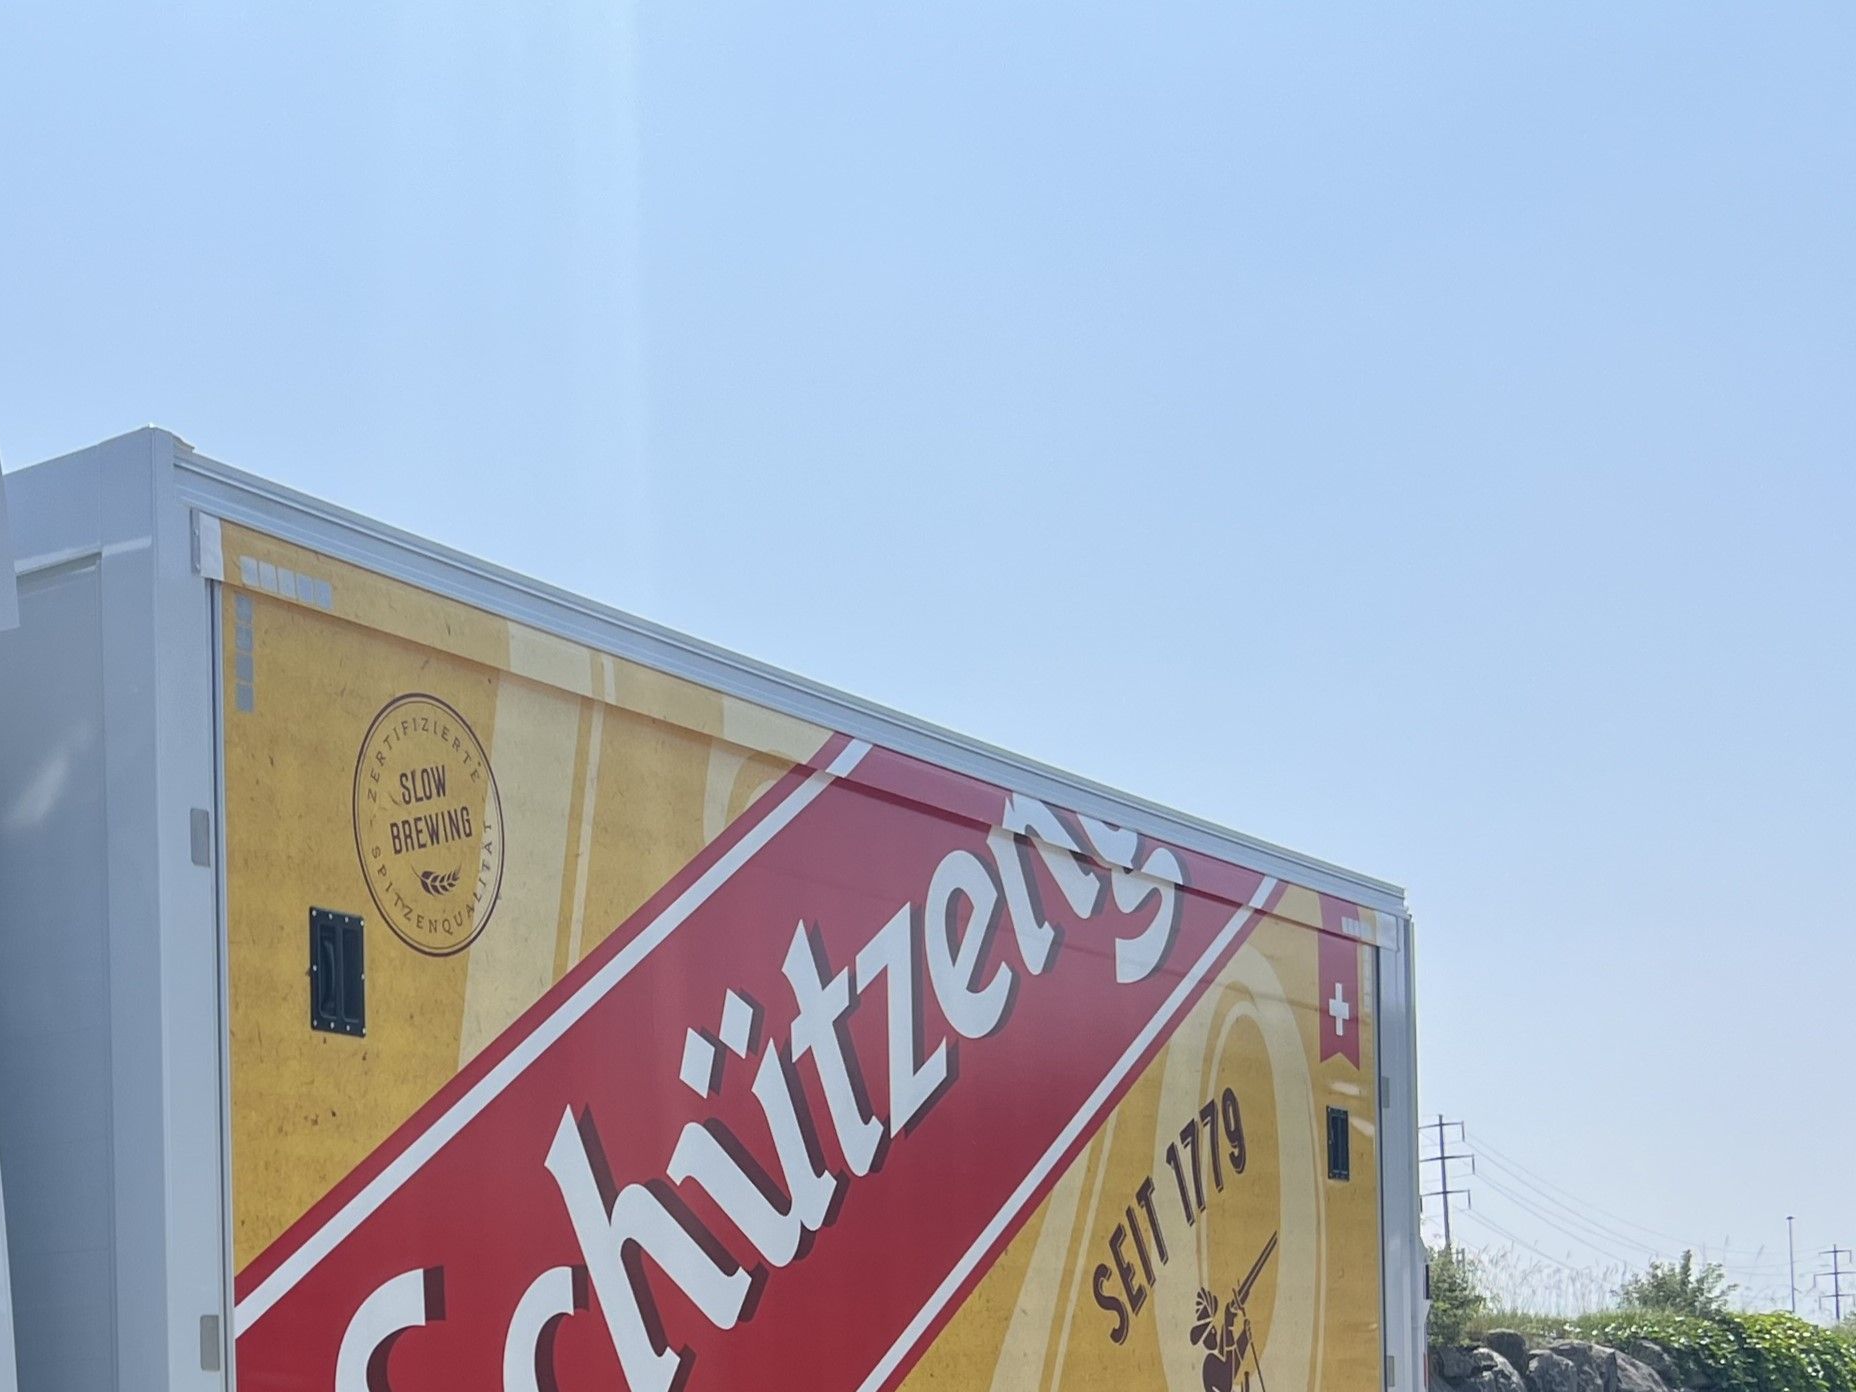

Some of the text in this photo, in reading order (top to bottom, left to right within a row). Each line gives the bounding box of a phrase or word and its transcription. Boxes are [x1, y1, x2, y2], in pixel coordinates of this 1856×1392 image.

[367, 717, 480, 804] ZERTIFIZIERTE
[399, 764, 447, 806] SLOW
[389, 806, 473, 855] BREWING
[1093, 1087, 1246, 1346] SEIT 1779
